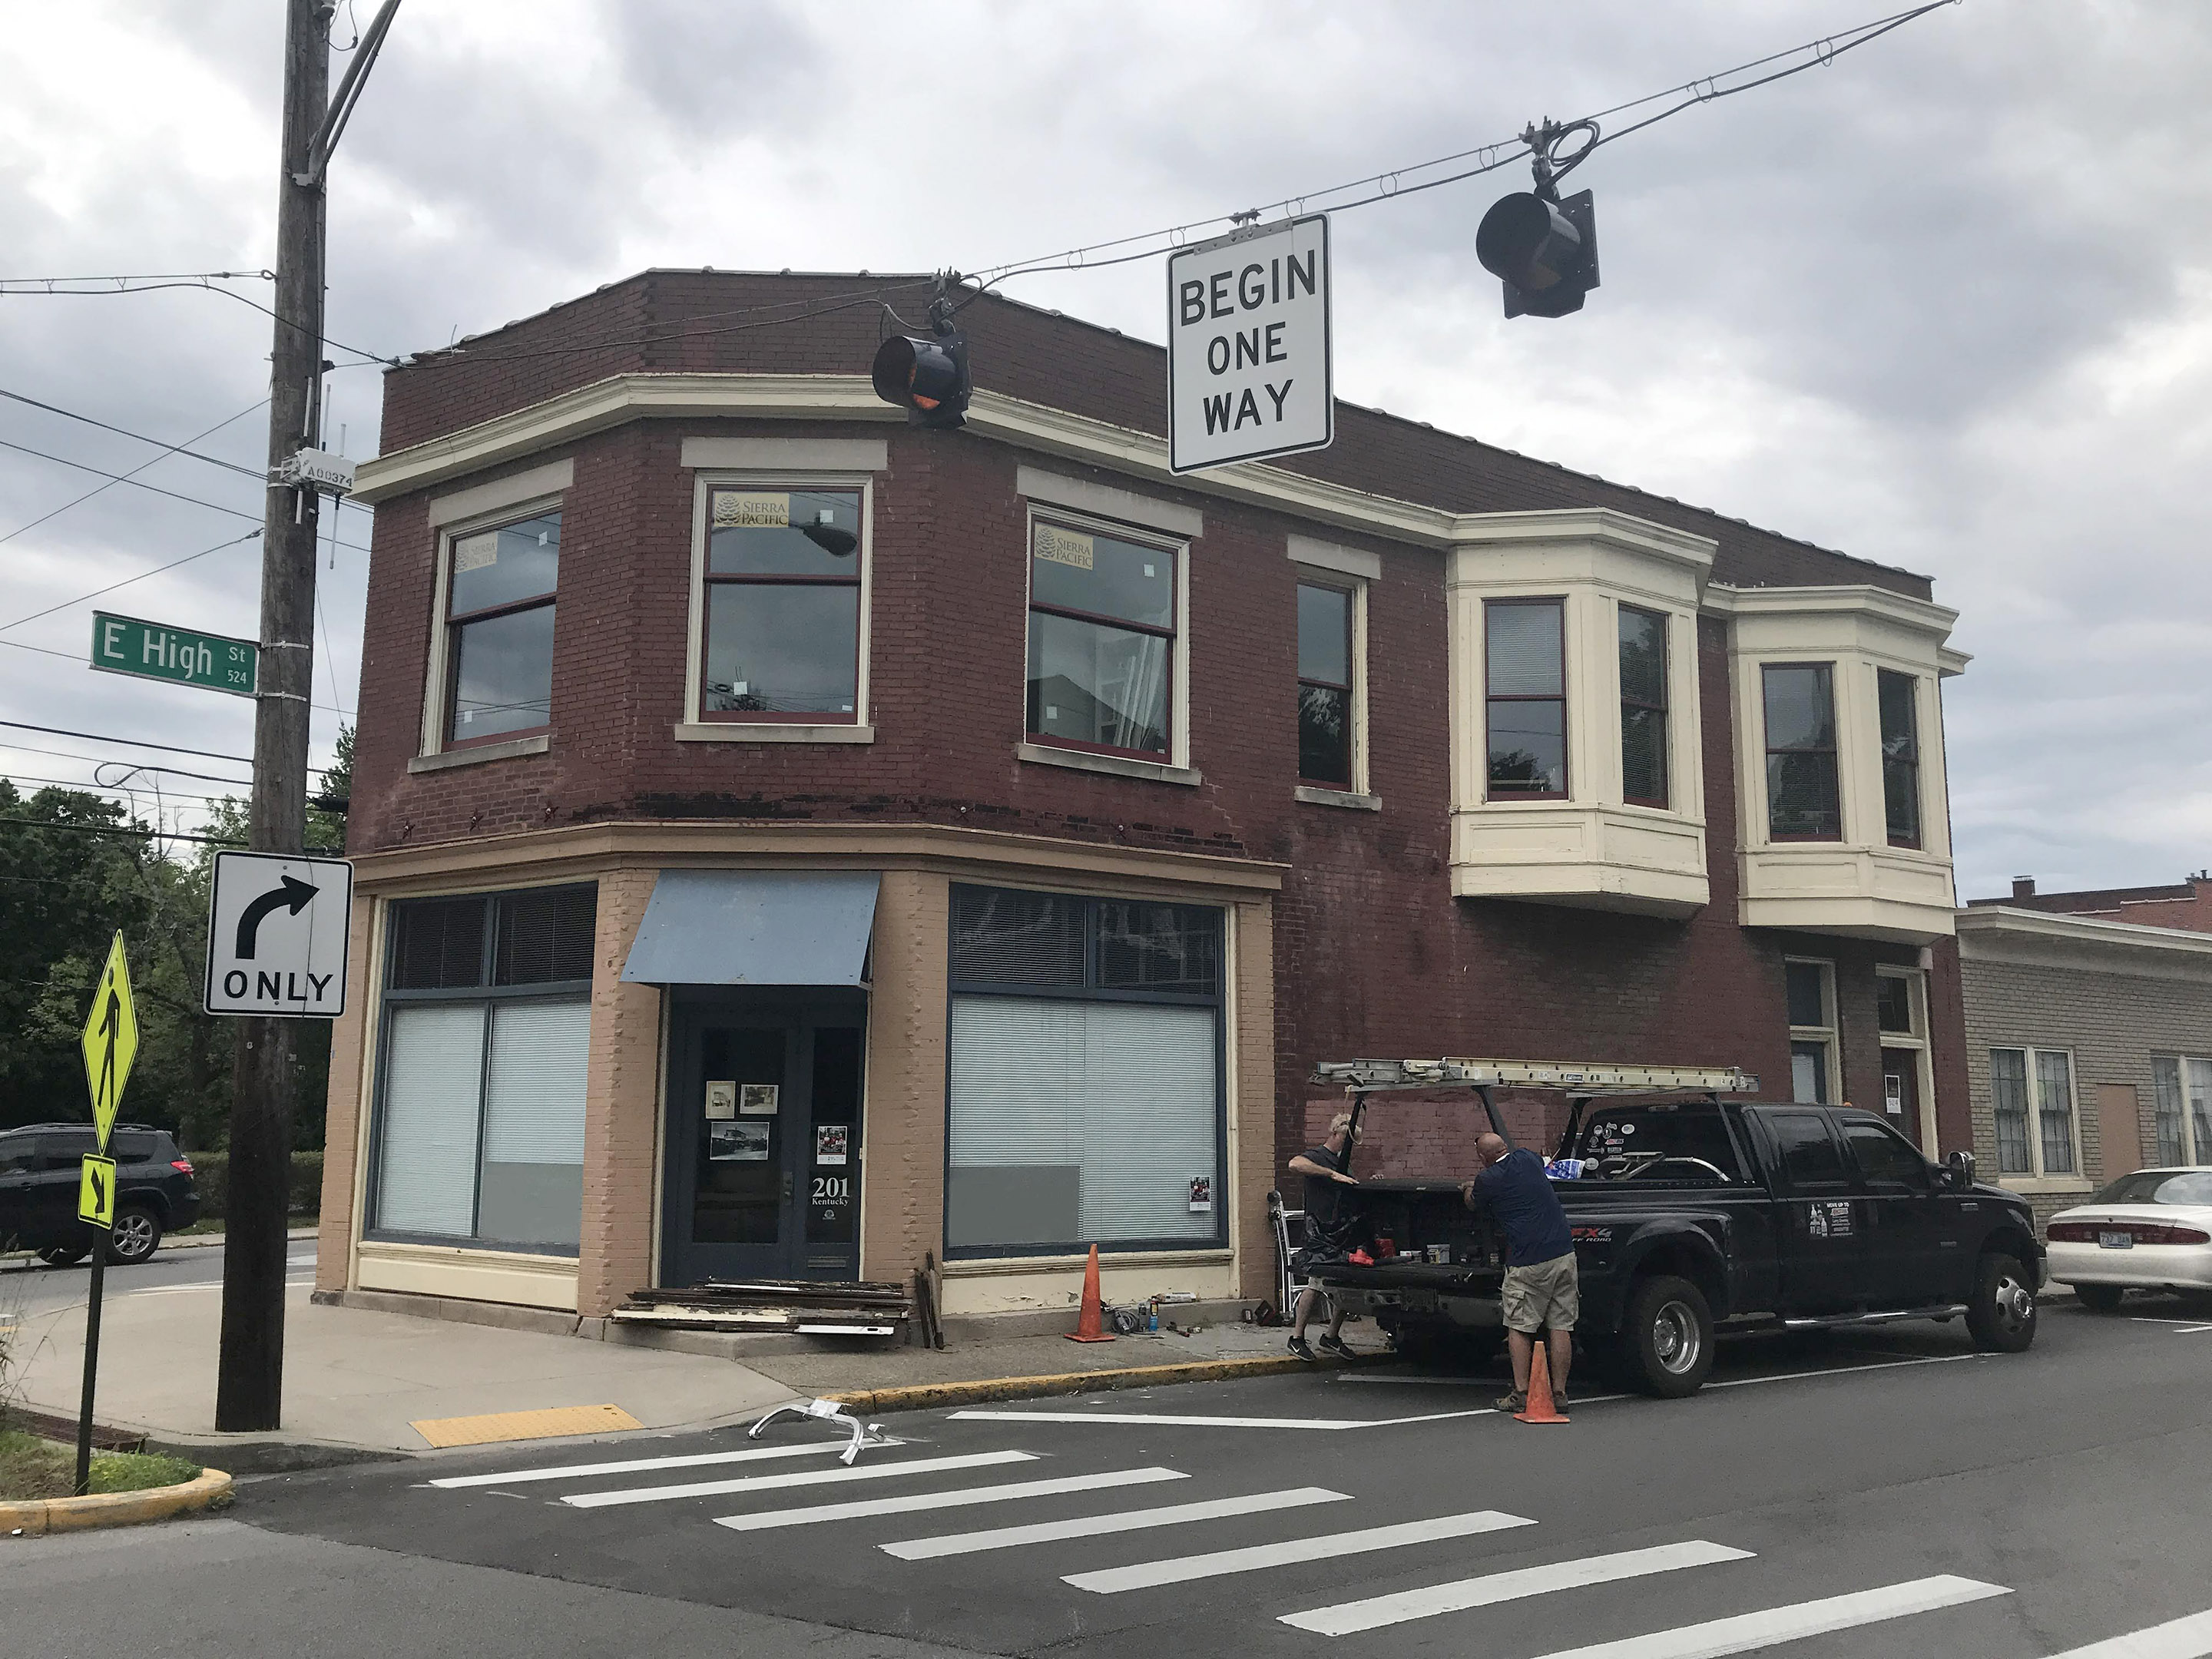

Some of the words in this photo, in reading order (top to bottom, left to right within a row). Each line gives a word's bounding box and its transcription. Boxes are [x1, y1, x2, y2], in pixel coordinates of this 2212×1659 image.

[1181, 250, 1315, 326] BEGIN
[1207, 321, 1287, 375] ONE
[1204, 379, 1293, 435] WAY
[307, 466, 353, 487] A00374
[742, 501, 786, 513] SIERRA
[742, 513, 788, 525] PACIFIC
[1057, 538, 1091, 556] SIERRA
[1056, 548, 1092, 568] PACIFIC
[104, 621, 126, 659] E
[142, 630, 212, 679] High
[229, 647, 245, 662] St
[227, 670, 247, 684] 524
[224, 970, 333, 1002] ONLY
[812, 1177, 849, 1197] 201
